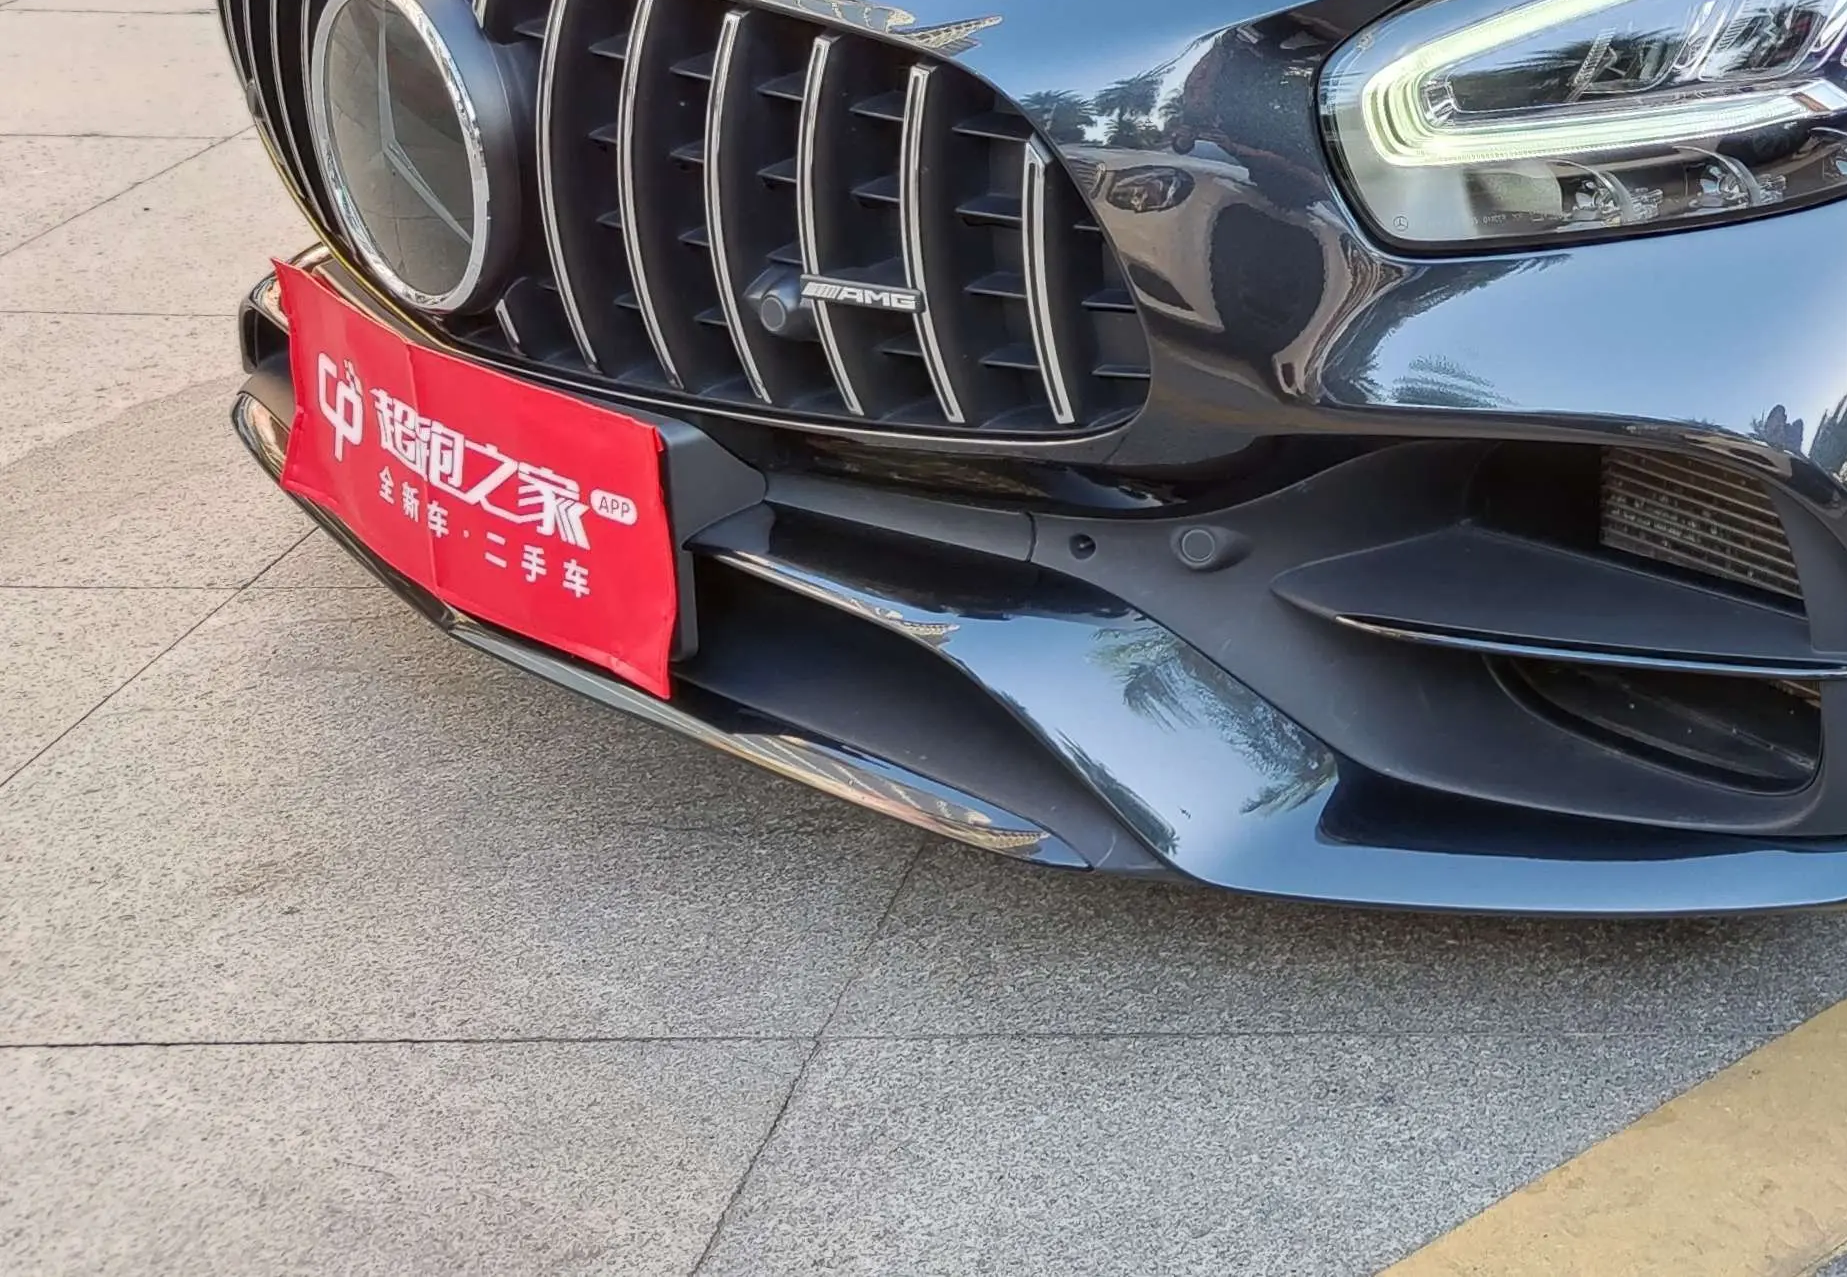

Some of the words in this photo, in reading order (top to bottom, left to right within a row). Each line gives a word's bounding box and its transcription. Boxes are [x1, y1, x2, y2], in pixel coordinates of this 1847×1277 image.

[837, 287, 916, 310] AMG
[369, 388, 591, 551] 超跑之家
[598, 495, 632, 518] APP
